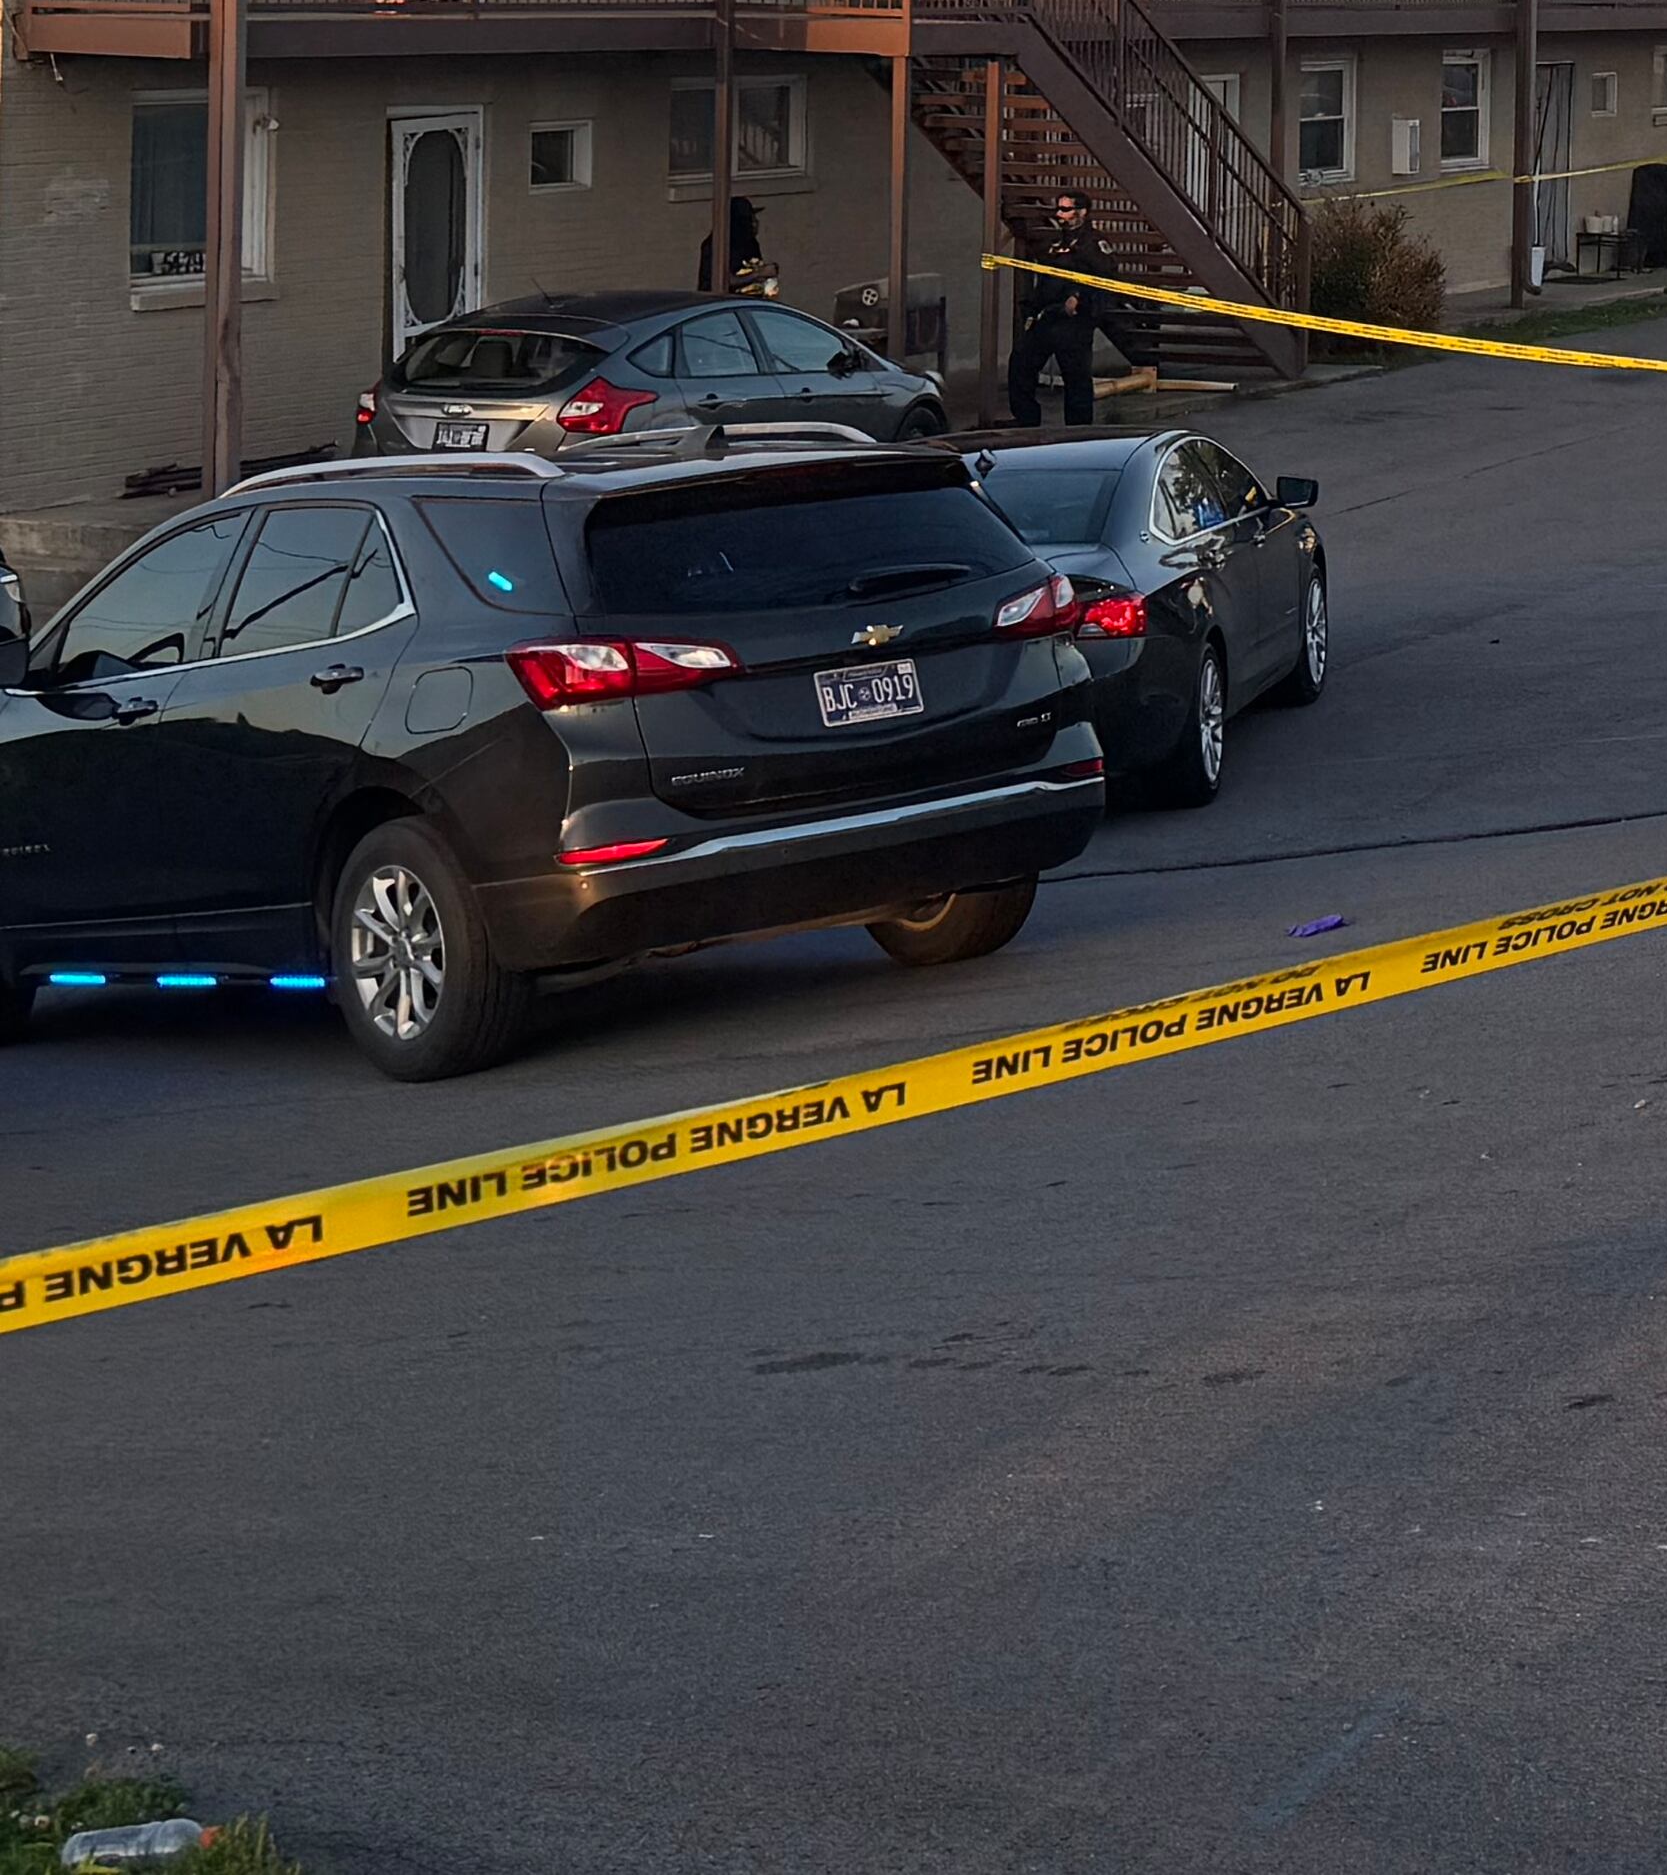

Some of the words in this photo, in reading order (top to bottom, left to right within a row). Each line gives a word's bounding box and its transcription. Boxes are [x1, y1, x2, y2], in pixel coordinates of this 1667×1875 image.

[822, 683, 858, 713] BJC
[871, 674, 914, 703] 0919
[1493, 915, 1598, 957] POLICE
[1421, 941, 1488, 974] LINE
[1335, 971, 1371, 997] LA
[1195, 982, 1324, 1031] VERGNE
[1061, 1014, 1188, 1064] POLICE
[972, 1045, 1052, 1085] LINE
[861, 1082, 906, 1114] LA
[690, 1096, 851, 1154] VERGNE
[522, 1132, 677, 1192] POLICE
[407, 1171, 507, 1217] LINE
[266, 1215, 323, 1251] LA
[44, 1232, 252, 1303] VERGNE
